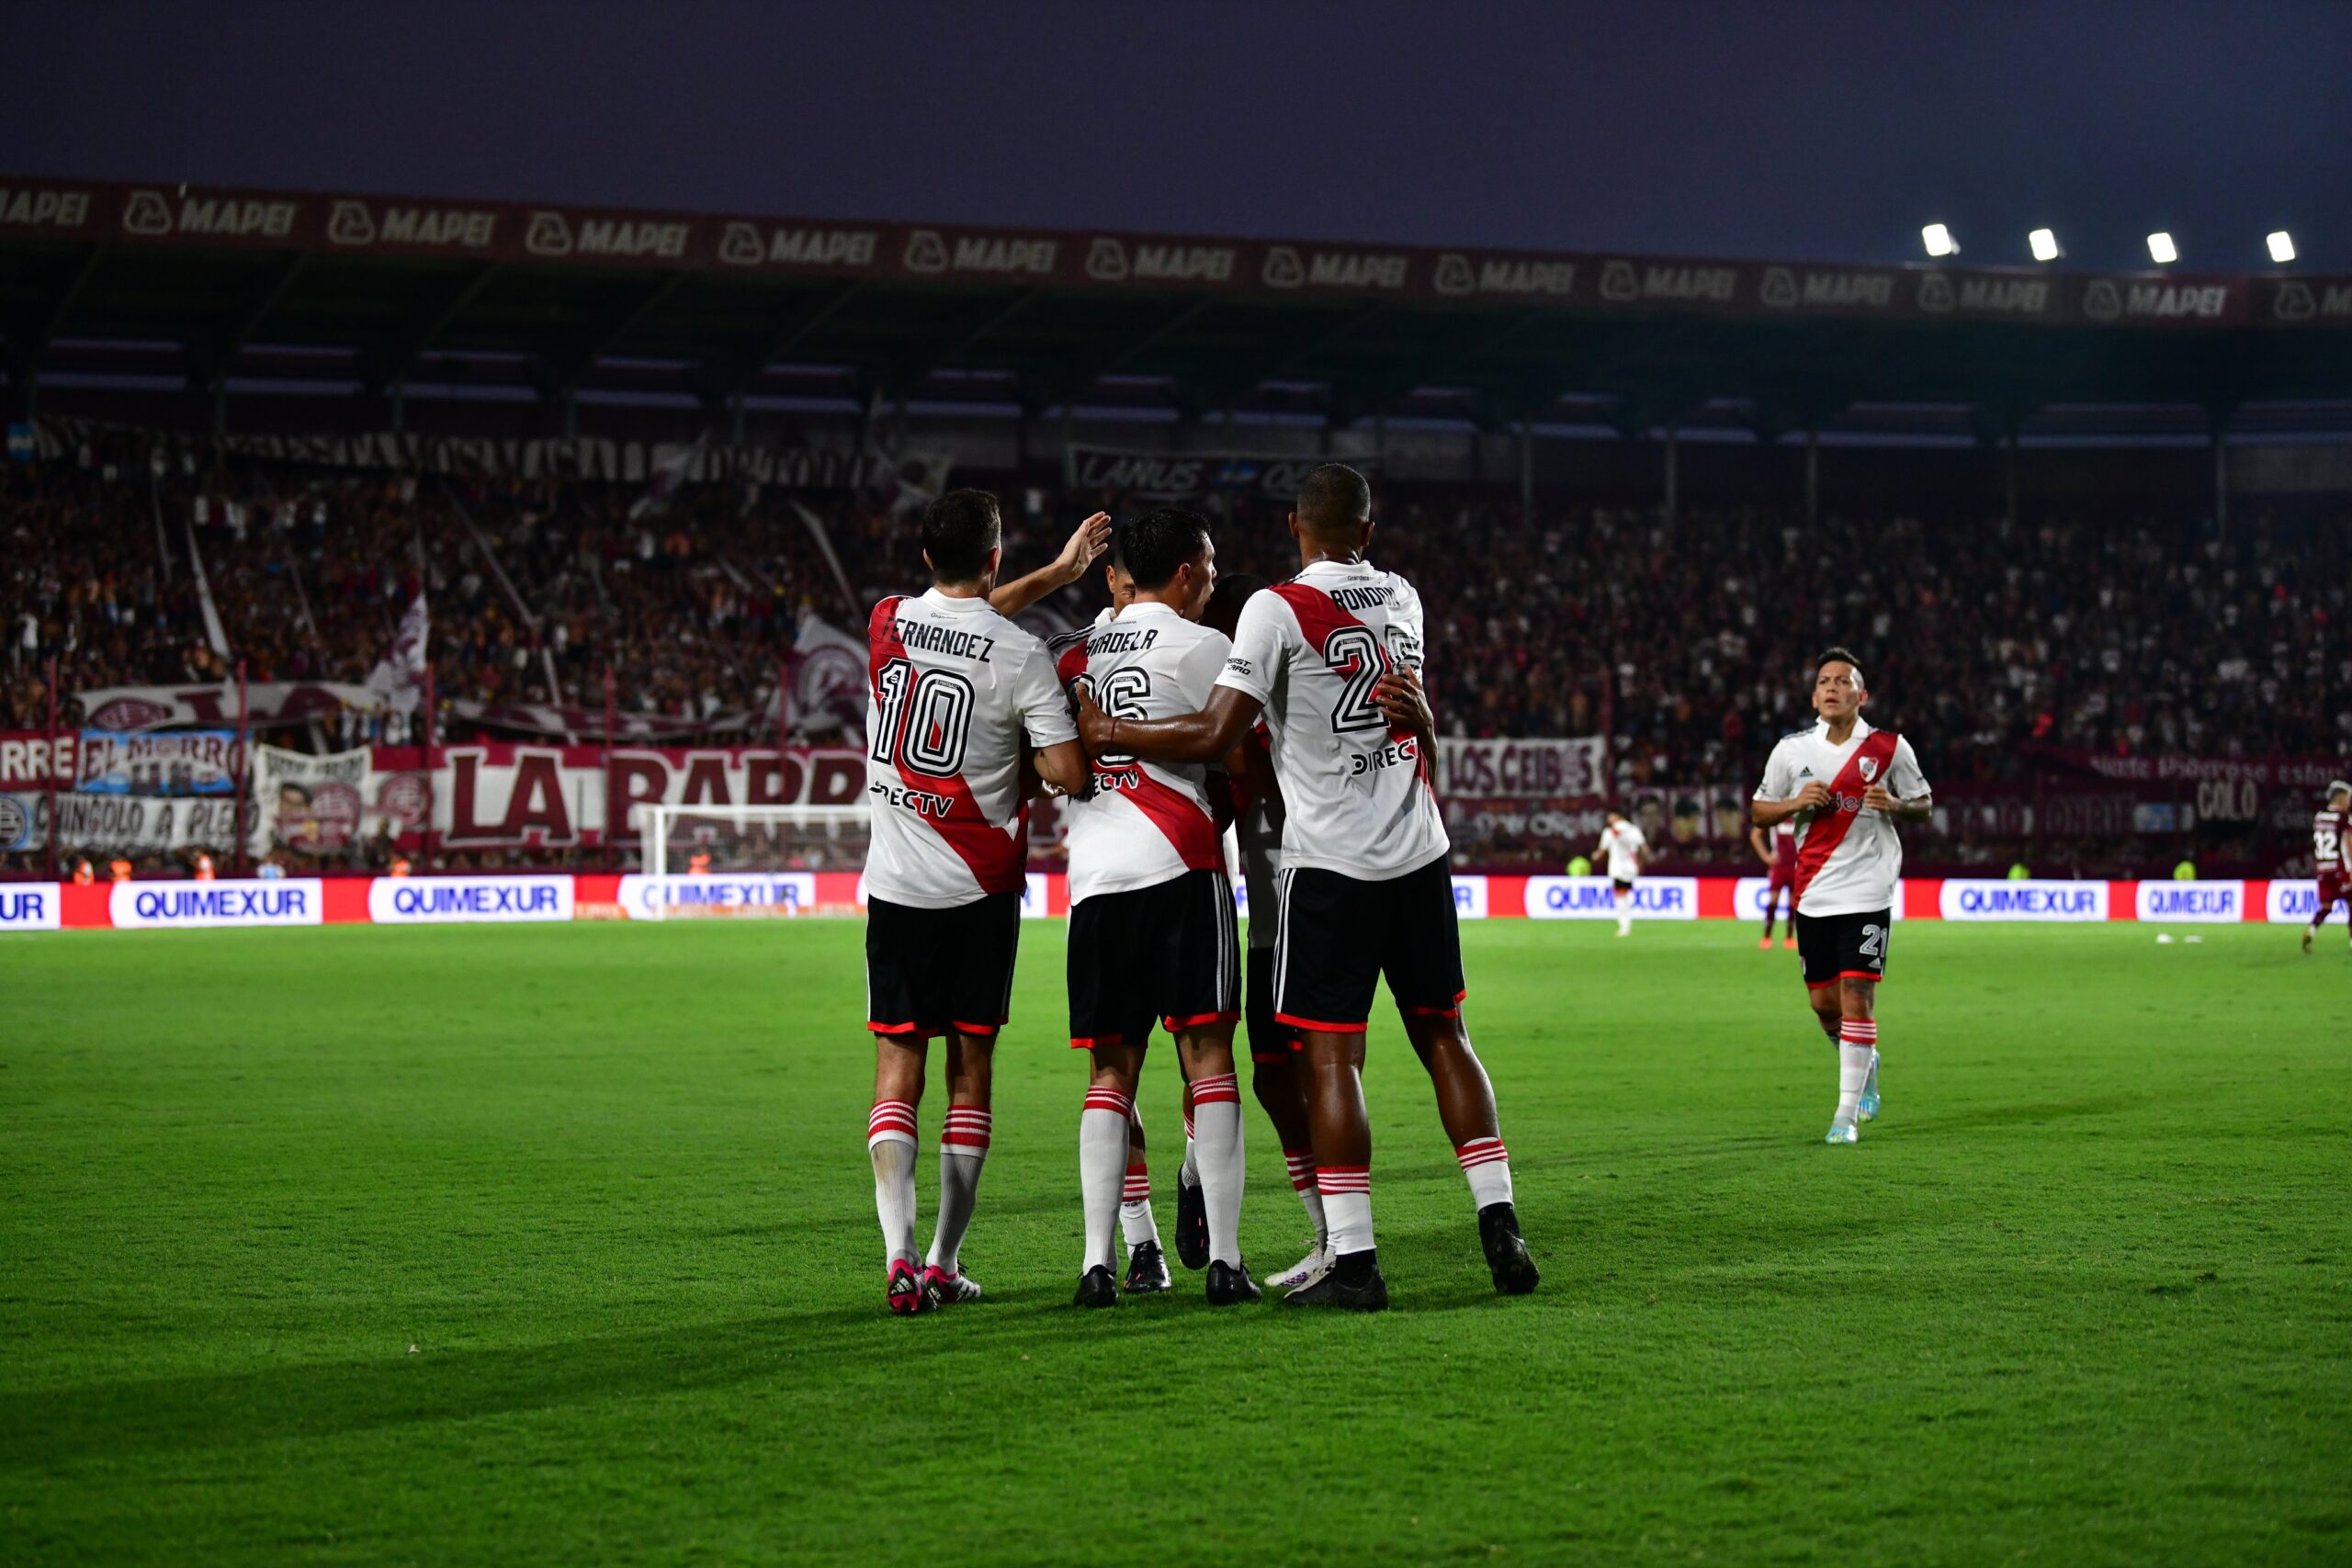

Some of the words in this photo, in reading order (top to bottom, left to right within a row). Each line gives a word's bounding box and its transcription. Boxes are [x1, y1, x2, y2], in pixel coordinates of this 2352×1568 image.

[178, 197, 298, 237] MAPEI
[381, 209, 497, 249] MAPEI
[577, 220, 690, 258] MAPEI
[770, 230, 879, 266] MAPEI
[953, 237, 1059, 275] MAPEI
[1134, 246, 1236, 281] MAPEI
[1309, 253, 1408, 289] MAPEI
[1481, 261, 1576, 295] MAPEI
[1644, 267, 1737, 301] MAPEI
[1803, 273, 1894, 307] MAPEI
[1959, 279, 2050, 312] MAPEI
[2125, 283, 2227, 318] MAPEI
[882, 616, 995, 663] FERNANDEZ
[1085, 629, 1159, 658] ARADELA
[1227, 664, 1251, 675] ARD
[872, 658, 976, 778] 10
[1067, 666, 1150, 768] 6
[1351, 737, 1417, 775] DIREC
[1448, 745, 1496, 792] LOS
[444, 749, 576, 843] LA
[605, 750, 869, 841] BARR
[869, 781, 956, 818] ECTV
[1084, 770, 1139, 800] ECTV
[155, 803, 174, 839] A
[136, 888, 306, 919] QUIMEXUR
[394, 886, 558, 916] QUIMEXUR
[1546, 885, 1684, 910] QUIMXUR
[1960, 887, 2096, 913] QUIMEXUR
[2148, 887, 2234, 912] QUIMEXUR
[1859, 924, 1888, 958] 21
